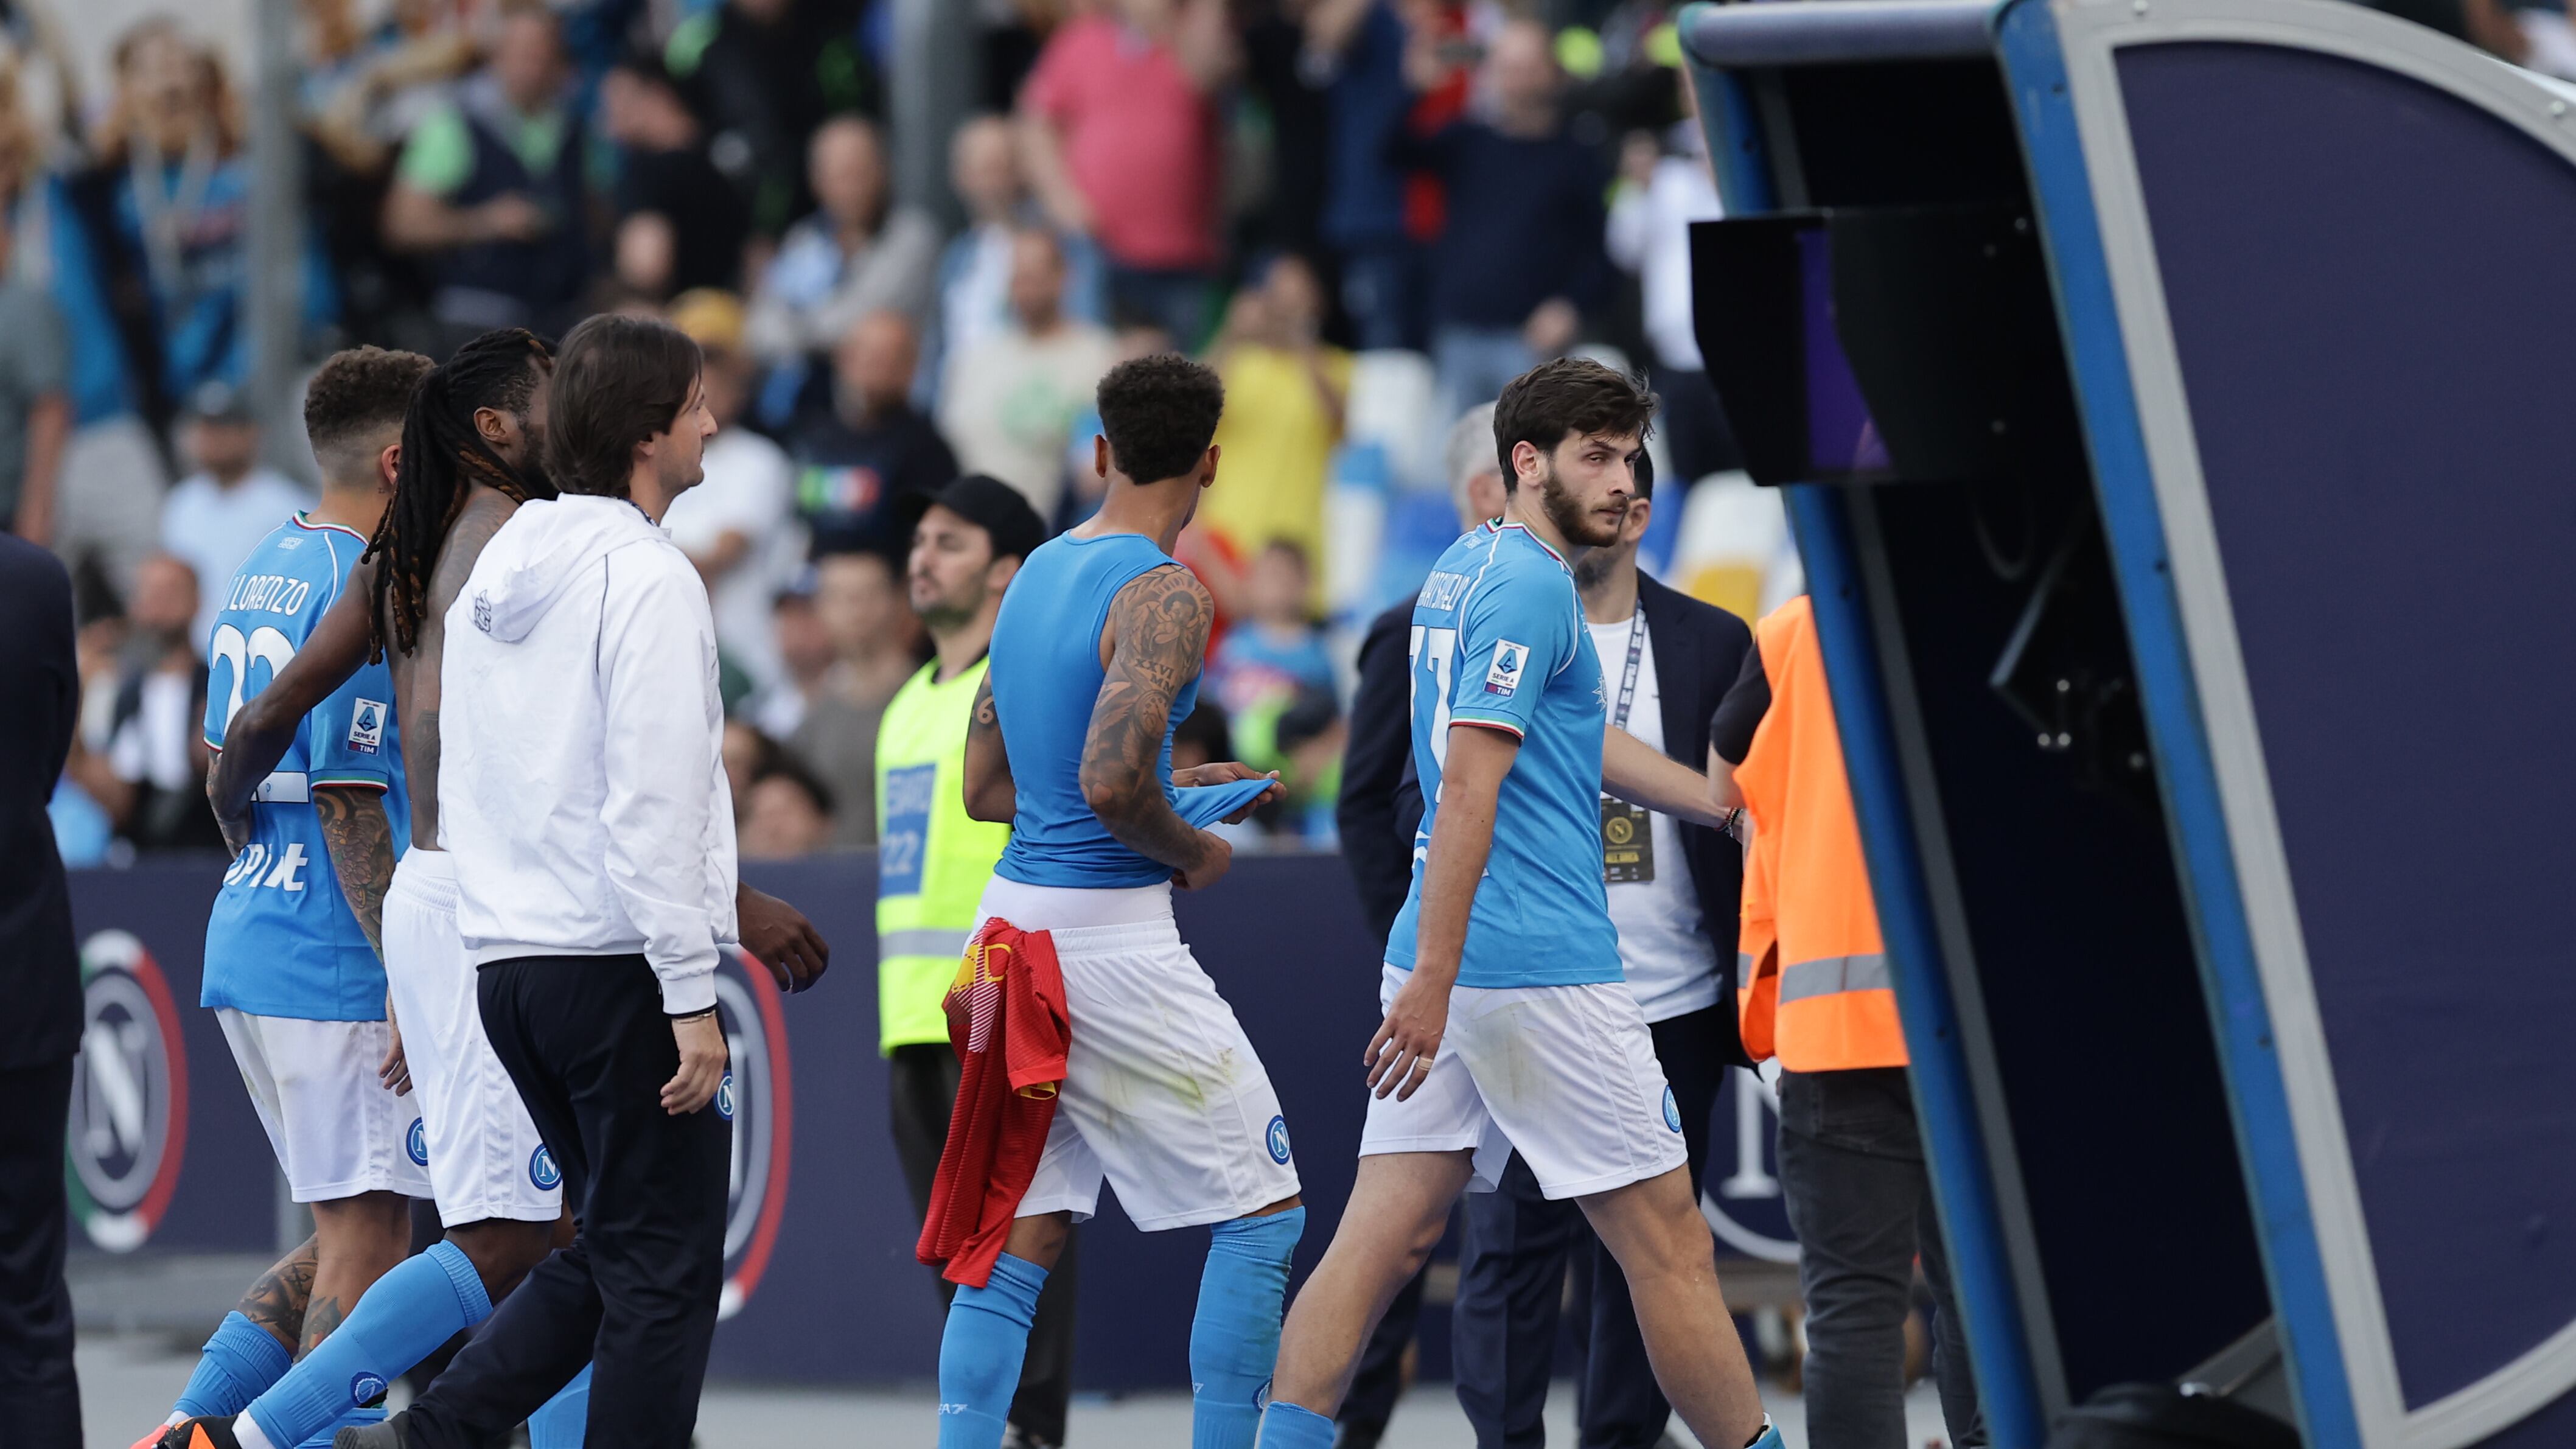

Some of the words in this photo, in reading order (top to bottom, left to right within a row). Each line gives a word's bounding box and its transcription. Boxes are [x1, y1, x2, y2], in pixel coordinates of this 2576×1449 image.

[229, 574, 309, 616] LORENZO
[1492, 672, 1509, 682] SERIE
[1497, 686, 1511, 696] TIM
[353, 731, 371, 739] SERIE
[360, 744, 374, 753] TIM
[1274, 1127, 1287, 1153] N
